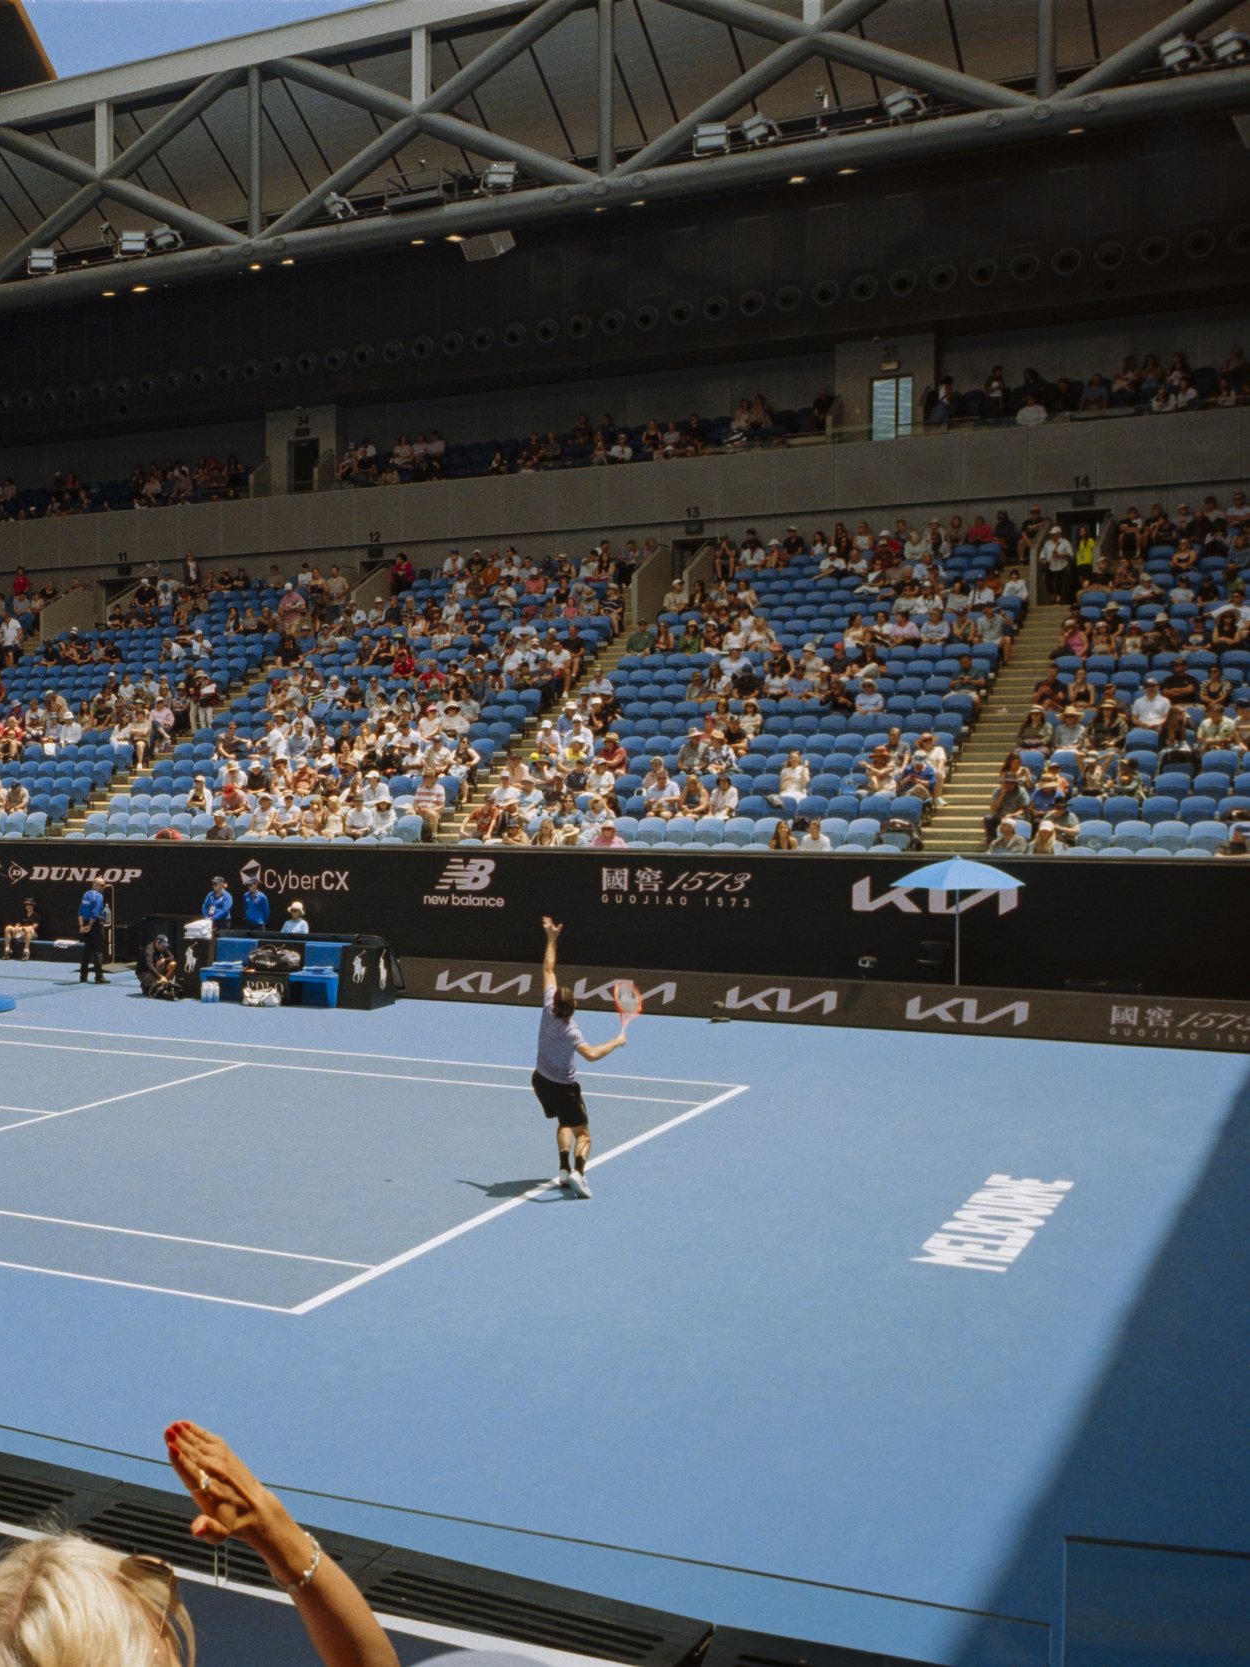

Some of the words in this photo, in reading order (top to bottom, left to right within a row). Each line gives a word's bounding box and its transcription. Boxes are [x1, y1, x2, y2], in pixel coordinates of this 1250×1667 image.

[296, 415, 308, 426] 34
[1074, 476, 1090, 489] 14
[685, 506, 700, 519] 13
[369, 532, 381, 543] 12
[117, 552, 128, 562] 11
[29, 866, 143, 884] DUNLOP
[264, 869, 350, 894] CyberCX
[423, 894, 449, 905] new
[451, 893, 506, 907] balance
[601, 894, 688, 907] GUOJIAO
[705, 896, 751, 908] 1573
[852, 876, 1019, 916] KIA
[435, 970, 533, 996] KIA
[725, 985, 838, 1016] KIA
[905, 995, 1030, 1027] KIA
[1109, 1026, 1198, 1040] GUOJIAO
[909, 1173, 1075, 1273] MELBOURNE
